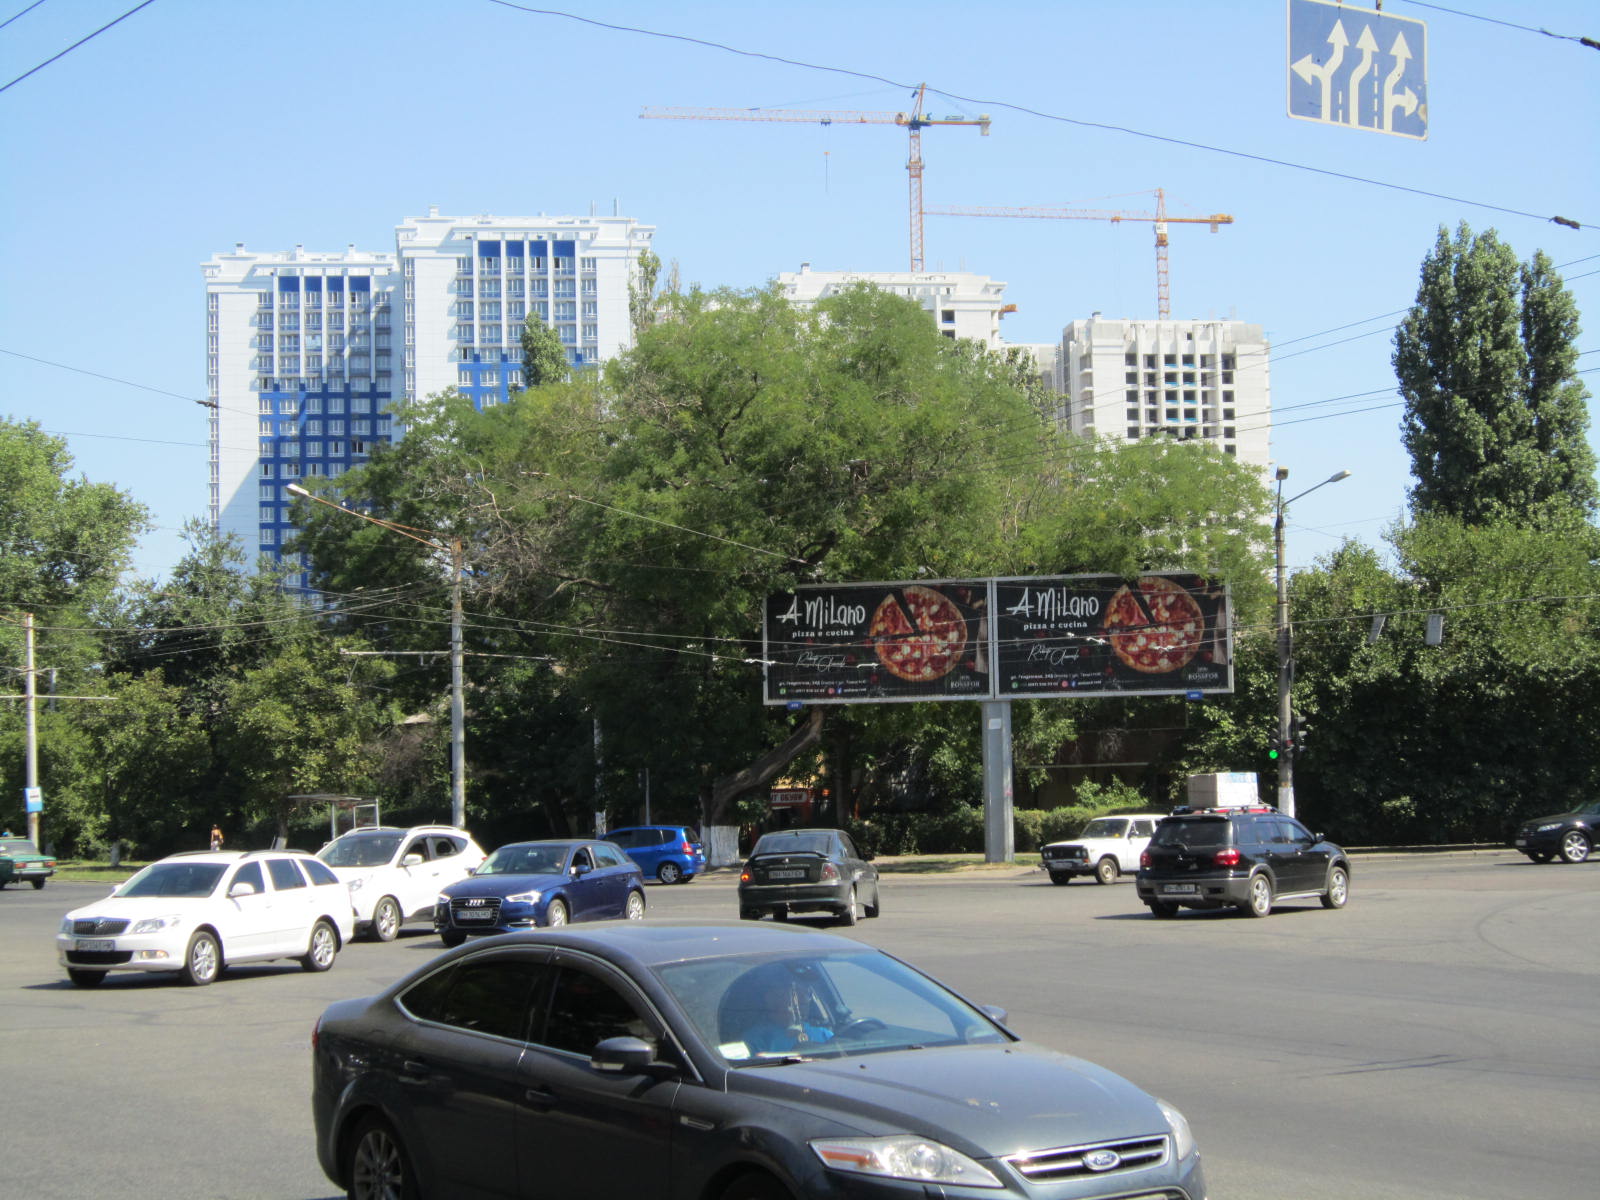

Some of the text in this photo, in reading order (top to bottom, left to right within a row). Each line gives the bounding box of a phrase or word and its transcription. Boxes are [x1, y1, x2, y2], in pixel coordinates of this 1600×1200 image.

[776, 595, 803, 626] A
[1006, 587, 1034, 618] A
[826, 629, 855, 637] cucina
[1024, 622, 1047, 631] pizza
[1058, 621, 1088, 629] cucina
